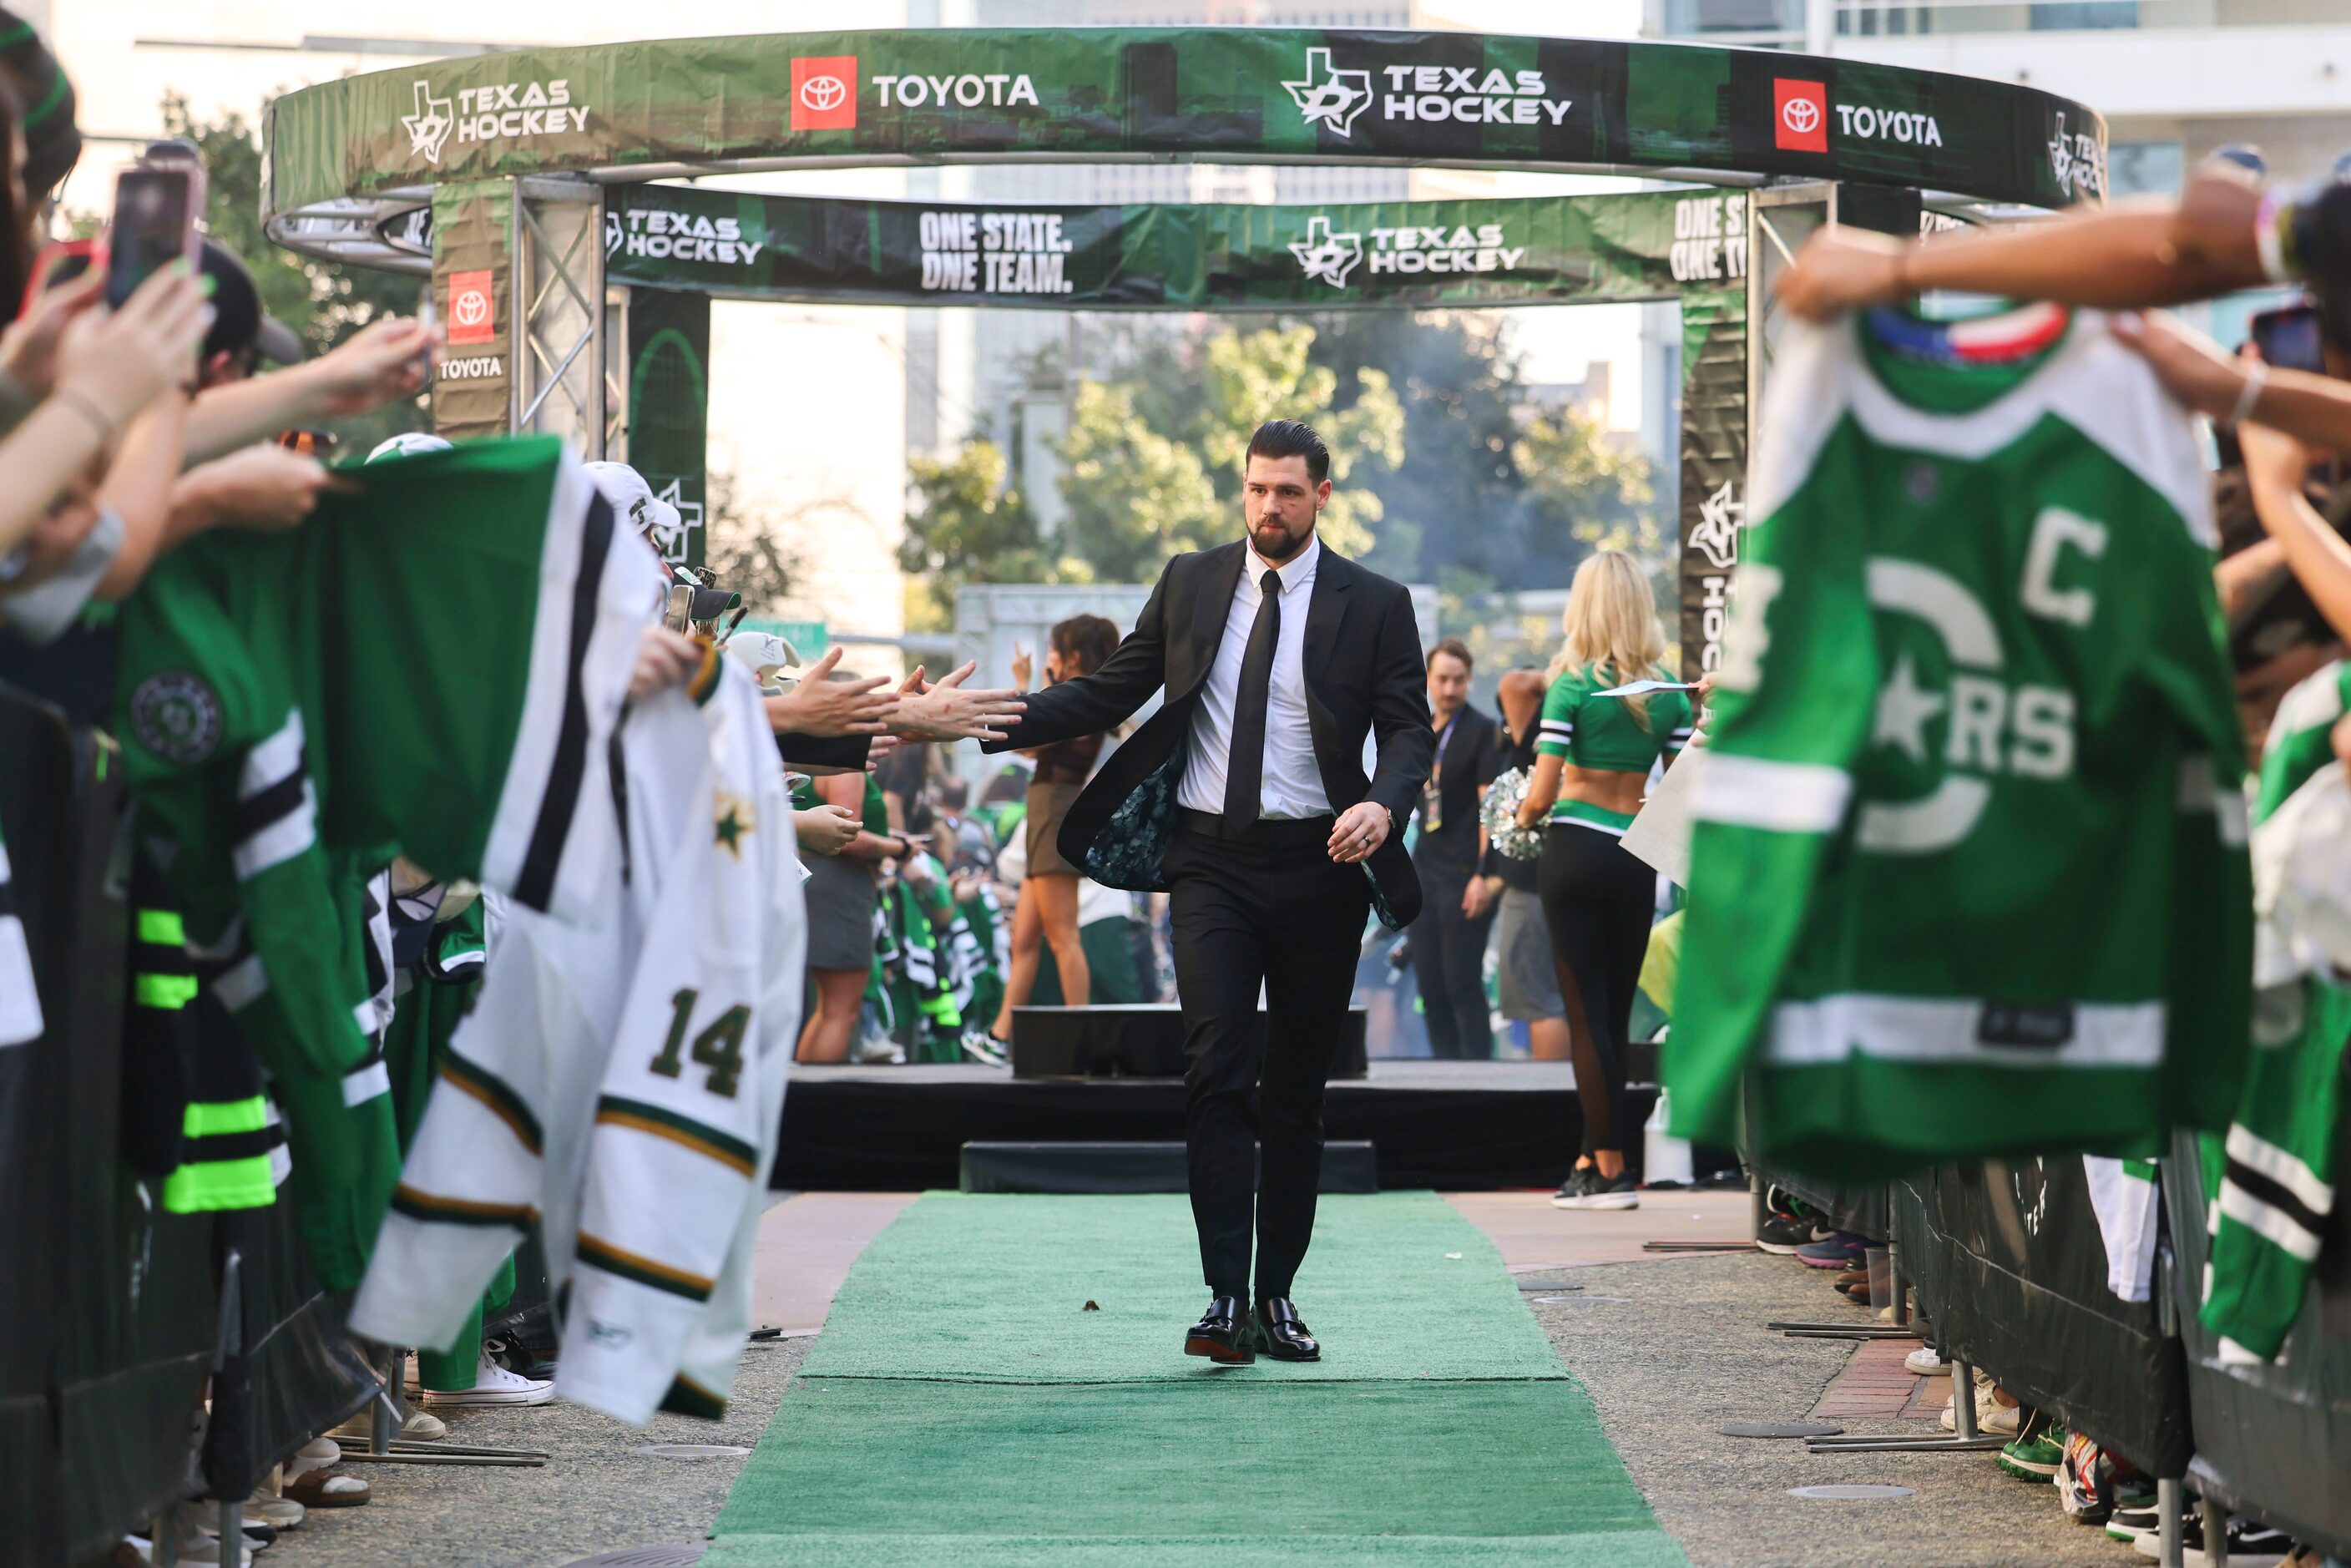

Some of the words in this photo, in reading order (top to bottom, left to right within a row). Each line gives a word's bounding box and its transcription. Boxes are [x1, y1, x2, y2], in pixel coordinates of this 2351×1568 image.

[458, 79, 570, 114] TEXAS
[872, 73, 1039, 108] TOYOTA
[1382, 65, 1547, 96] TEXAS
[458, 105, 591, 144] HOCKEY
[1383, 94, 1572, 126] HOCKEY
[1836, 104, 1942, 148] TOYOTA
[626, 209, 741, 242] TEXAS
[920, 211, 977, 251] ONE
[982, 213, 1073, 252] STATE.
[1675, 197, 1722, 240] ONE
[626, 232, 764, 266] HOCKEY
[1369, 224, 1504, 250] TEXAS
[920, 252, 978, 293] ONE
[983, 253, 1074, 294] TEAM.
[1368, 246, 1525, 274] HOCKEY
[1670, 238, 1722, 281] ONE
[439, 356, 502, 381] TOYOTA
[2022, 506, 2108, 627] C
[650, 987, 751, 1100] 14
